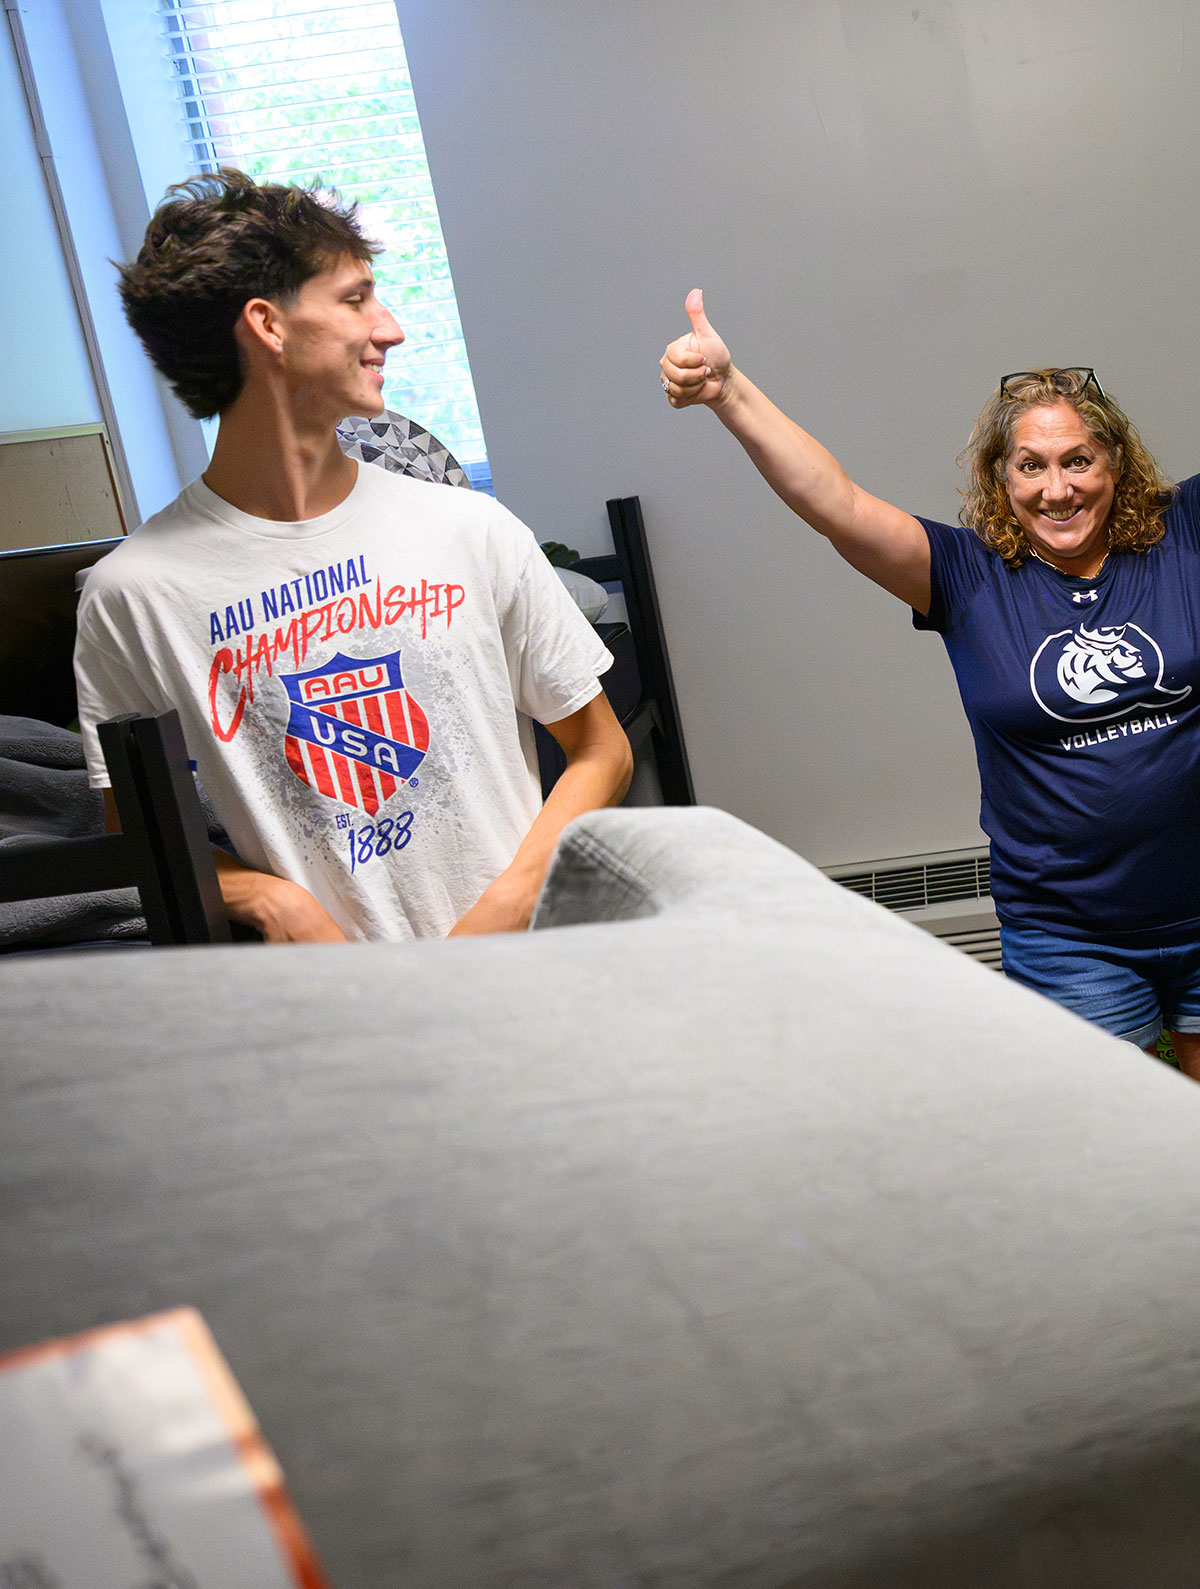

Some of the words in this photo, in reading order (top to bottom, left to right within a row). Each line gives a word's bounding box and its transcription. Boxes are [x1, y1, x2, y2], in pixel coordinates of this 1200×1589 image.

[210, 598, 255, 645] AAU
[261, 555, 372, 622] NATIONAL
[208, 573, 465, 743] CHAMPIONSHIP
[304, 666, 384, 699] AAU
[309, 715, 401, 773] USA
[1060, 713, 1178, 751] VOLLEYBALL
[335, 813, 354, 830] EST.
[348, 811, 414, 874] 1888
